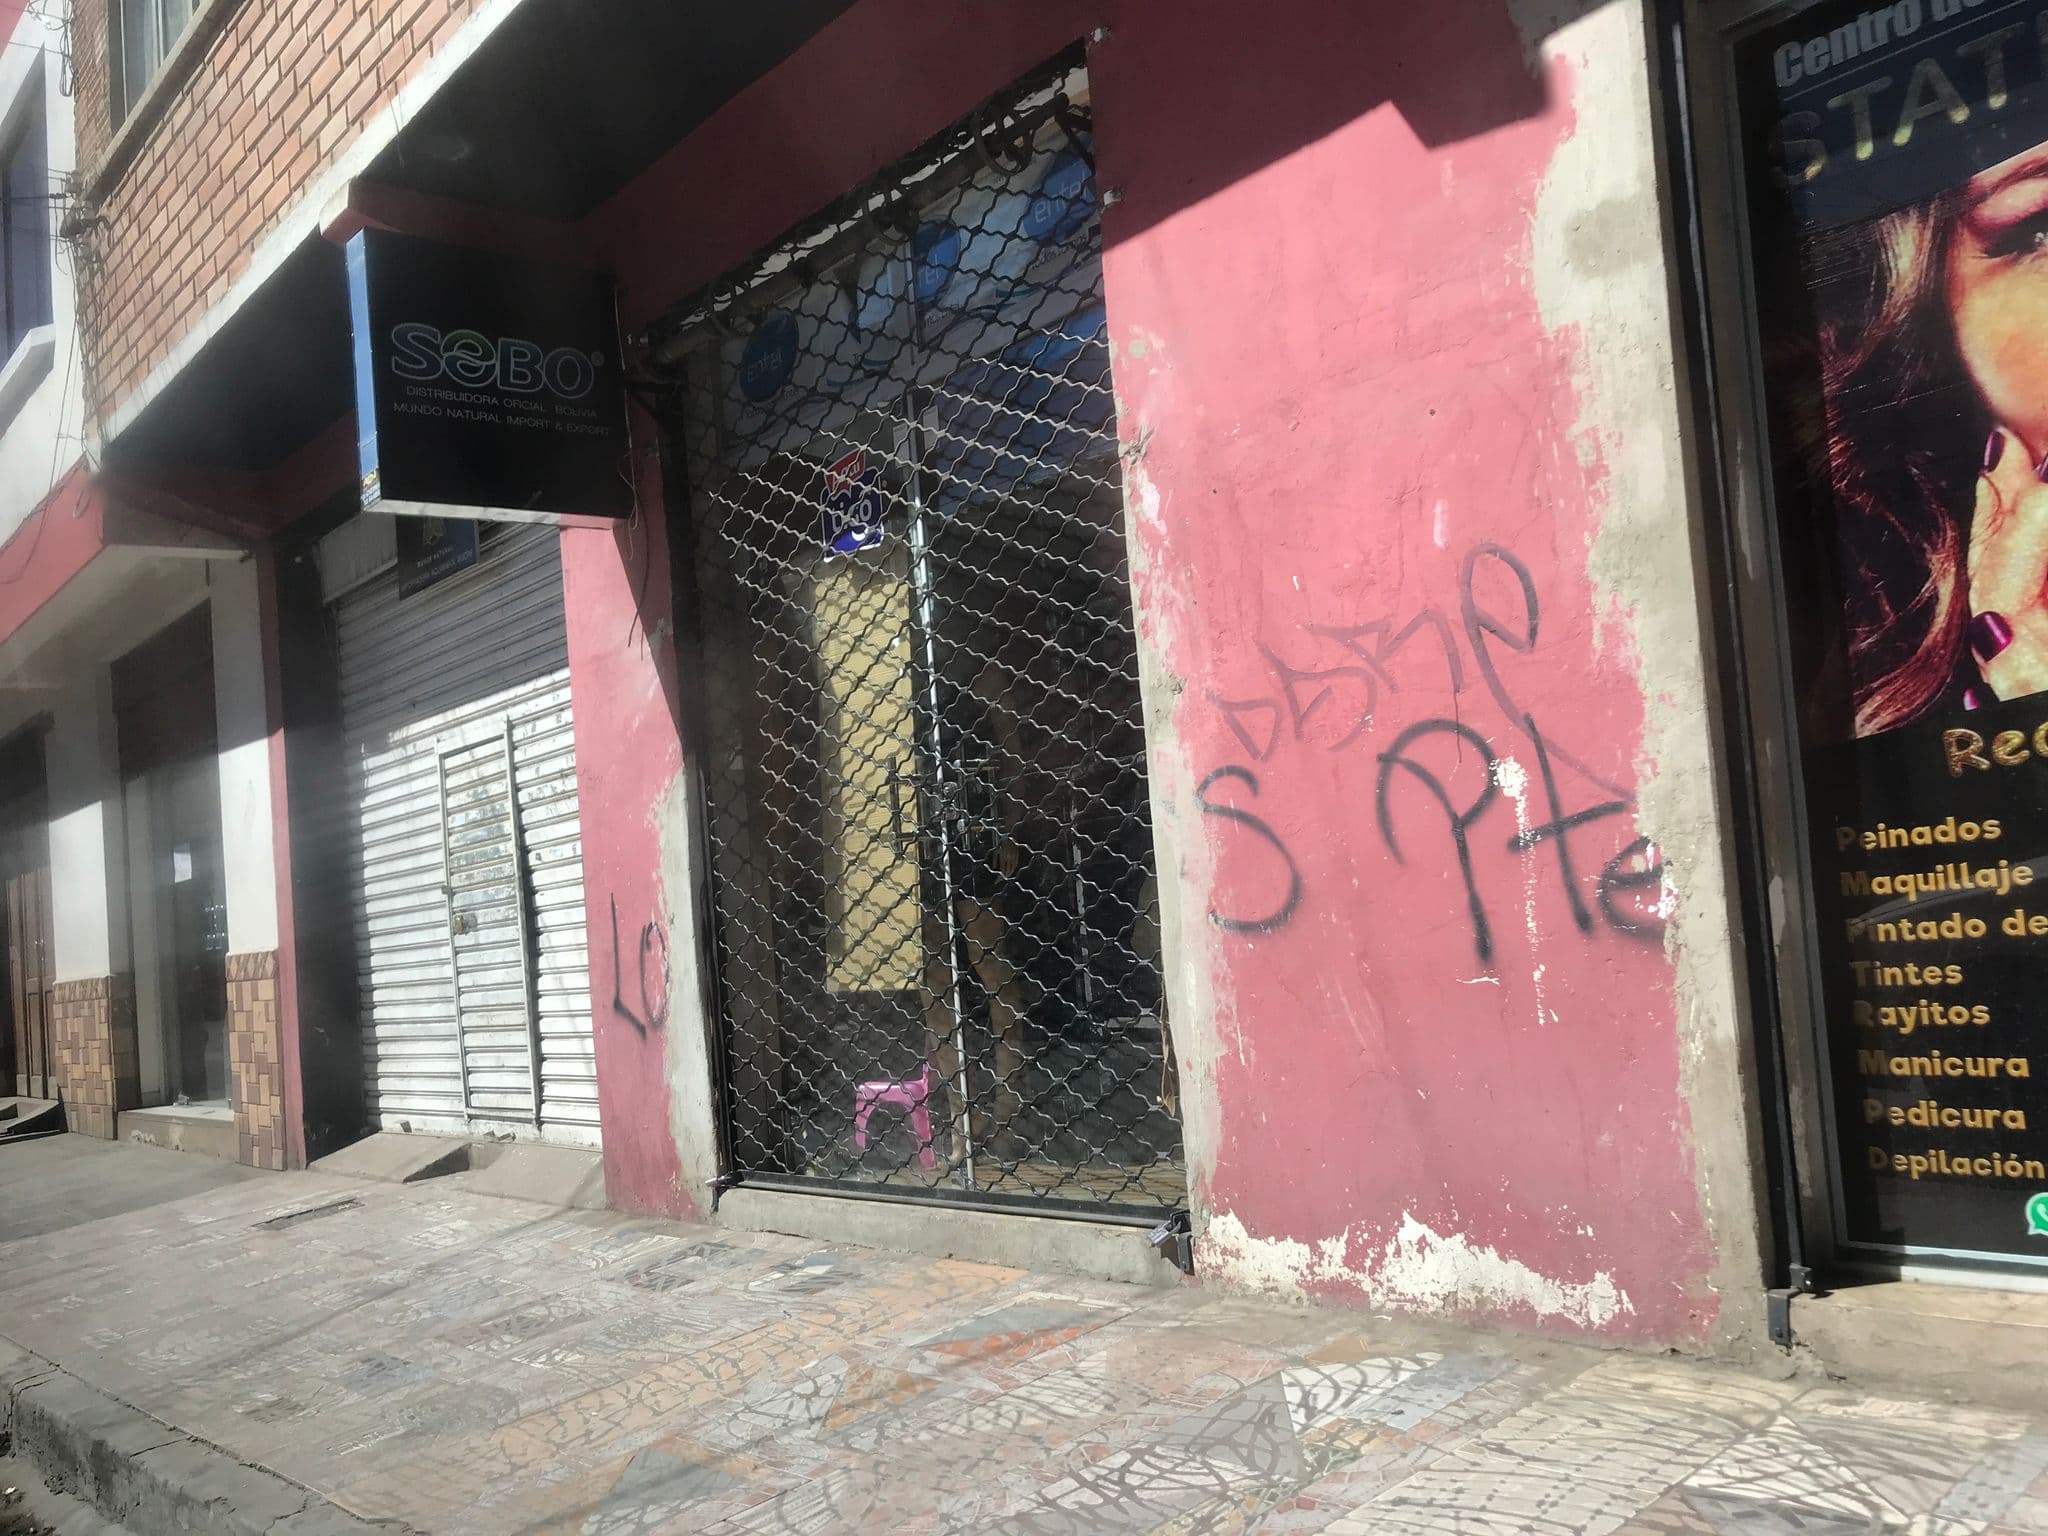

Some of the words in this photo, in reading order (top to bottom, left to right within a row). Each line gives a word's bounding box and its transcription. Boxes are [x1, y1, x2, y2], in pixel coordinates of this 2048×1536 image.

[1773, 0, 1922, 88] Centro
[1780, 8, 2048, 185] STAT
[406, 385, 500, 407] DISTRIBUIDORA
[503, 397, 546, 412] OFICIAL
[555, 404, 598, 419] BOLIVIA
[393, 402, 442, 417] MUNDO
[446, 407, 502, 424] NATURAL
[506, 415, 550, 430] IMPORT
[566, 423, 610, 438] EXPORT
[1836, 817, 2002, 852] Peinados
[1841, 859, 2033, 901] Maquillaje
[1845, 911, 1987, 944] Pintado
[2001, 908, 2048, 937] de
[1850, 959, 1964, 988] Tintes
[1854, 998, 1990, 1035] Rayitos
[1859, 1048, 2030, 1079] Manicura
[1863, 1098, 2027, 1131] Pedicura
[1867, 1146, 2046, 1181] Depilación
